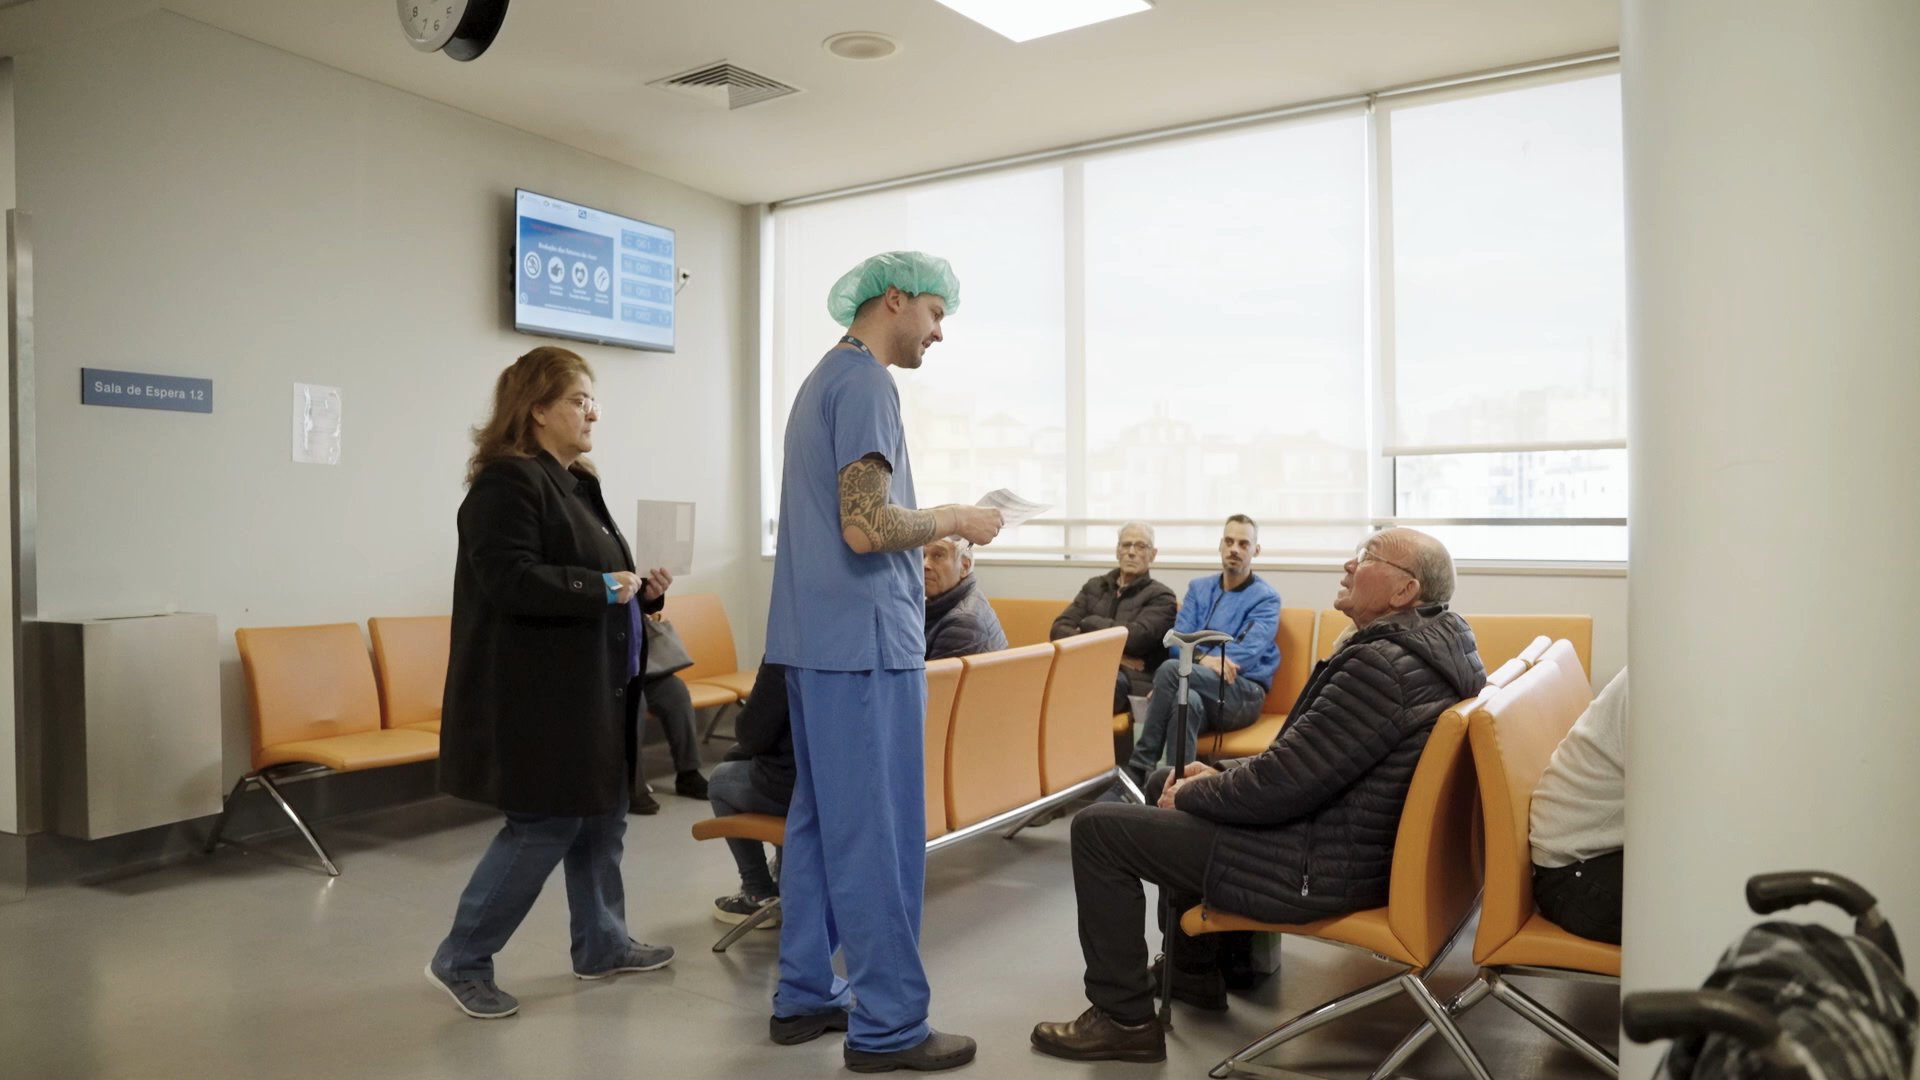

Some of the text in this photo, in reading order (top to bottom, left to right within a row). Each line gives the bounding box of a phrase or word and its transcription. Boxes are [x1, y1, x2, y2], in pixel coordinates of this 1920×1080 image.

[412, 6, 418, 18] 8
[422, 18, 428, 31] 7
[433, 19, 440, 31] 6
[94, 381, 204, 401] Sala de Espera 1.2
